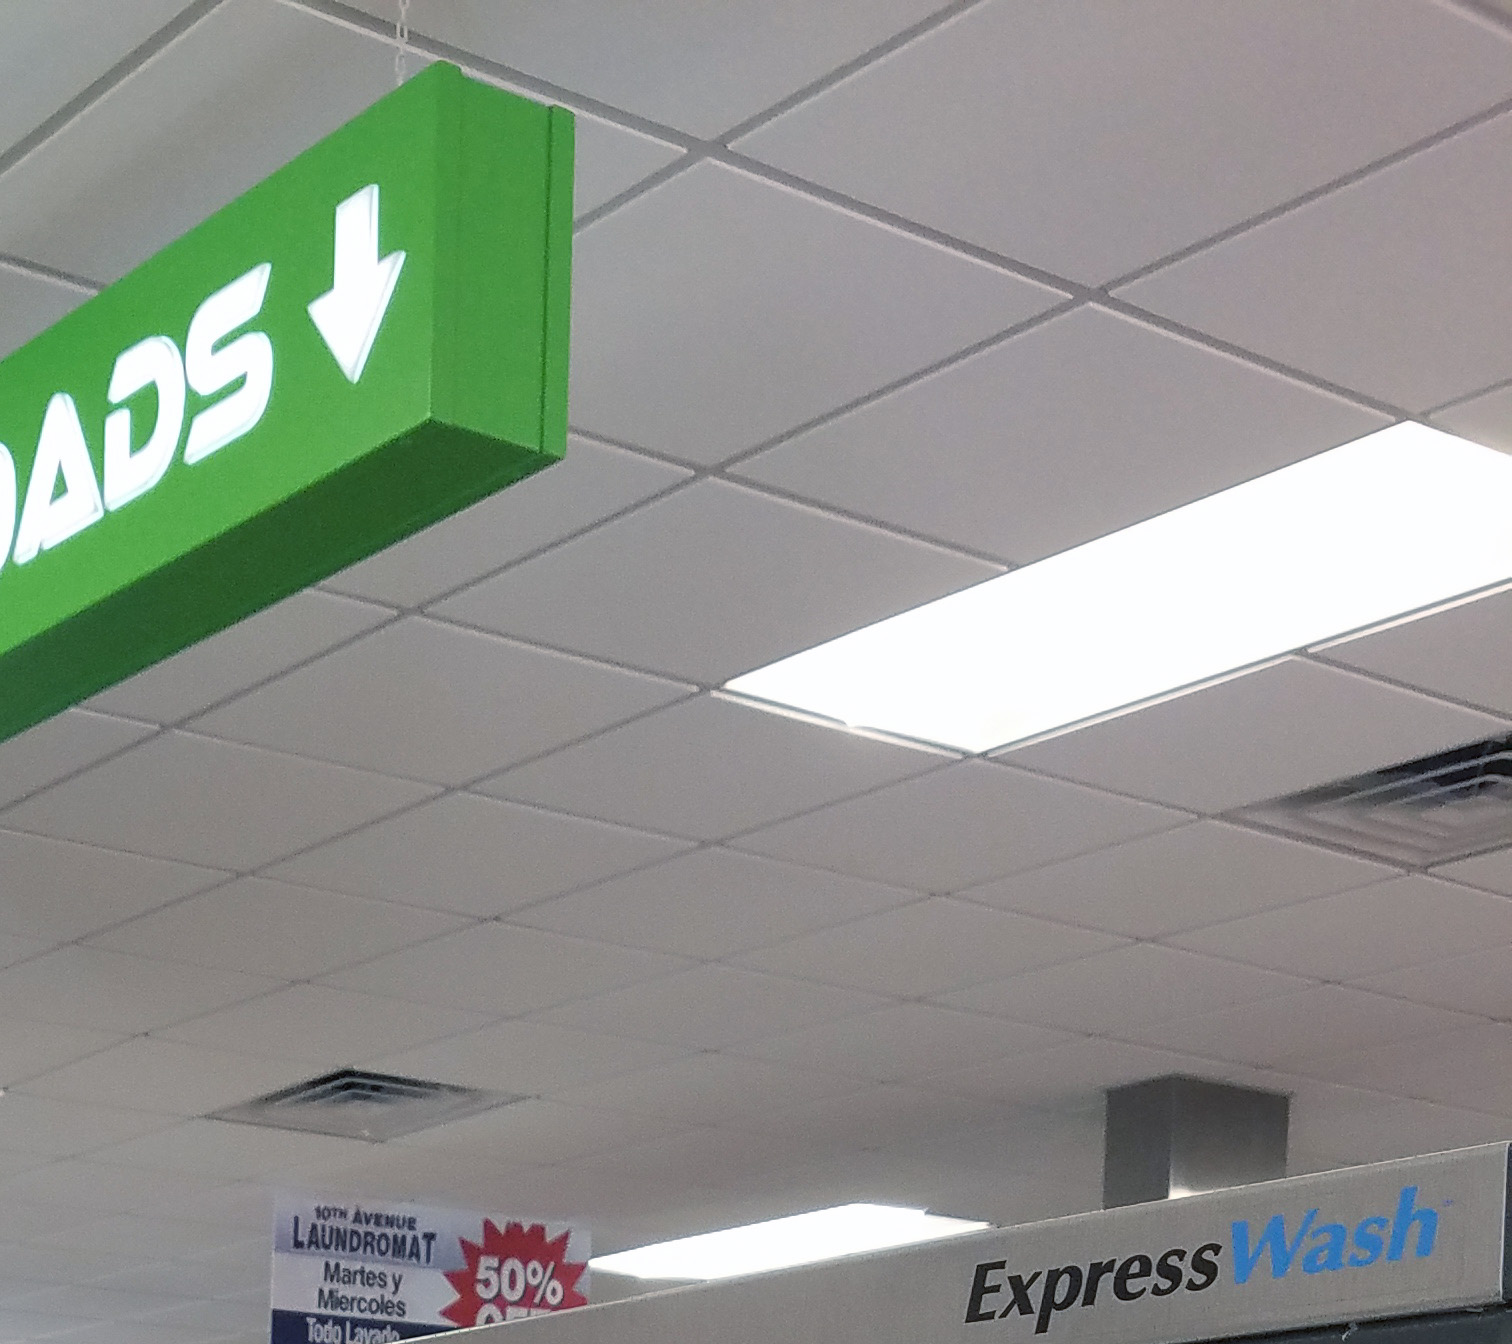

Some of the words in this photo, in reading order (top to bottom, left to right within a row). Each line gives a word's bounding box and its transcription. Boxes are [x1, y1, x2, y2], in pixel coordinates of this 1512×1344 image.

[324, 1260, 387, 1288] Martes
[391, 1272, 403, 1295] y
[475, 1255, 565, 1307] 50%
[318, 1288, 407, 1318] Miercoles
[306, 1317, 342, 1344] Todo
